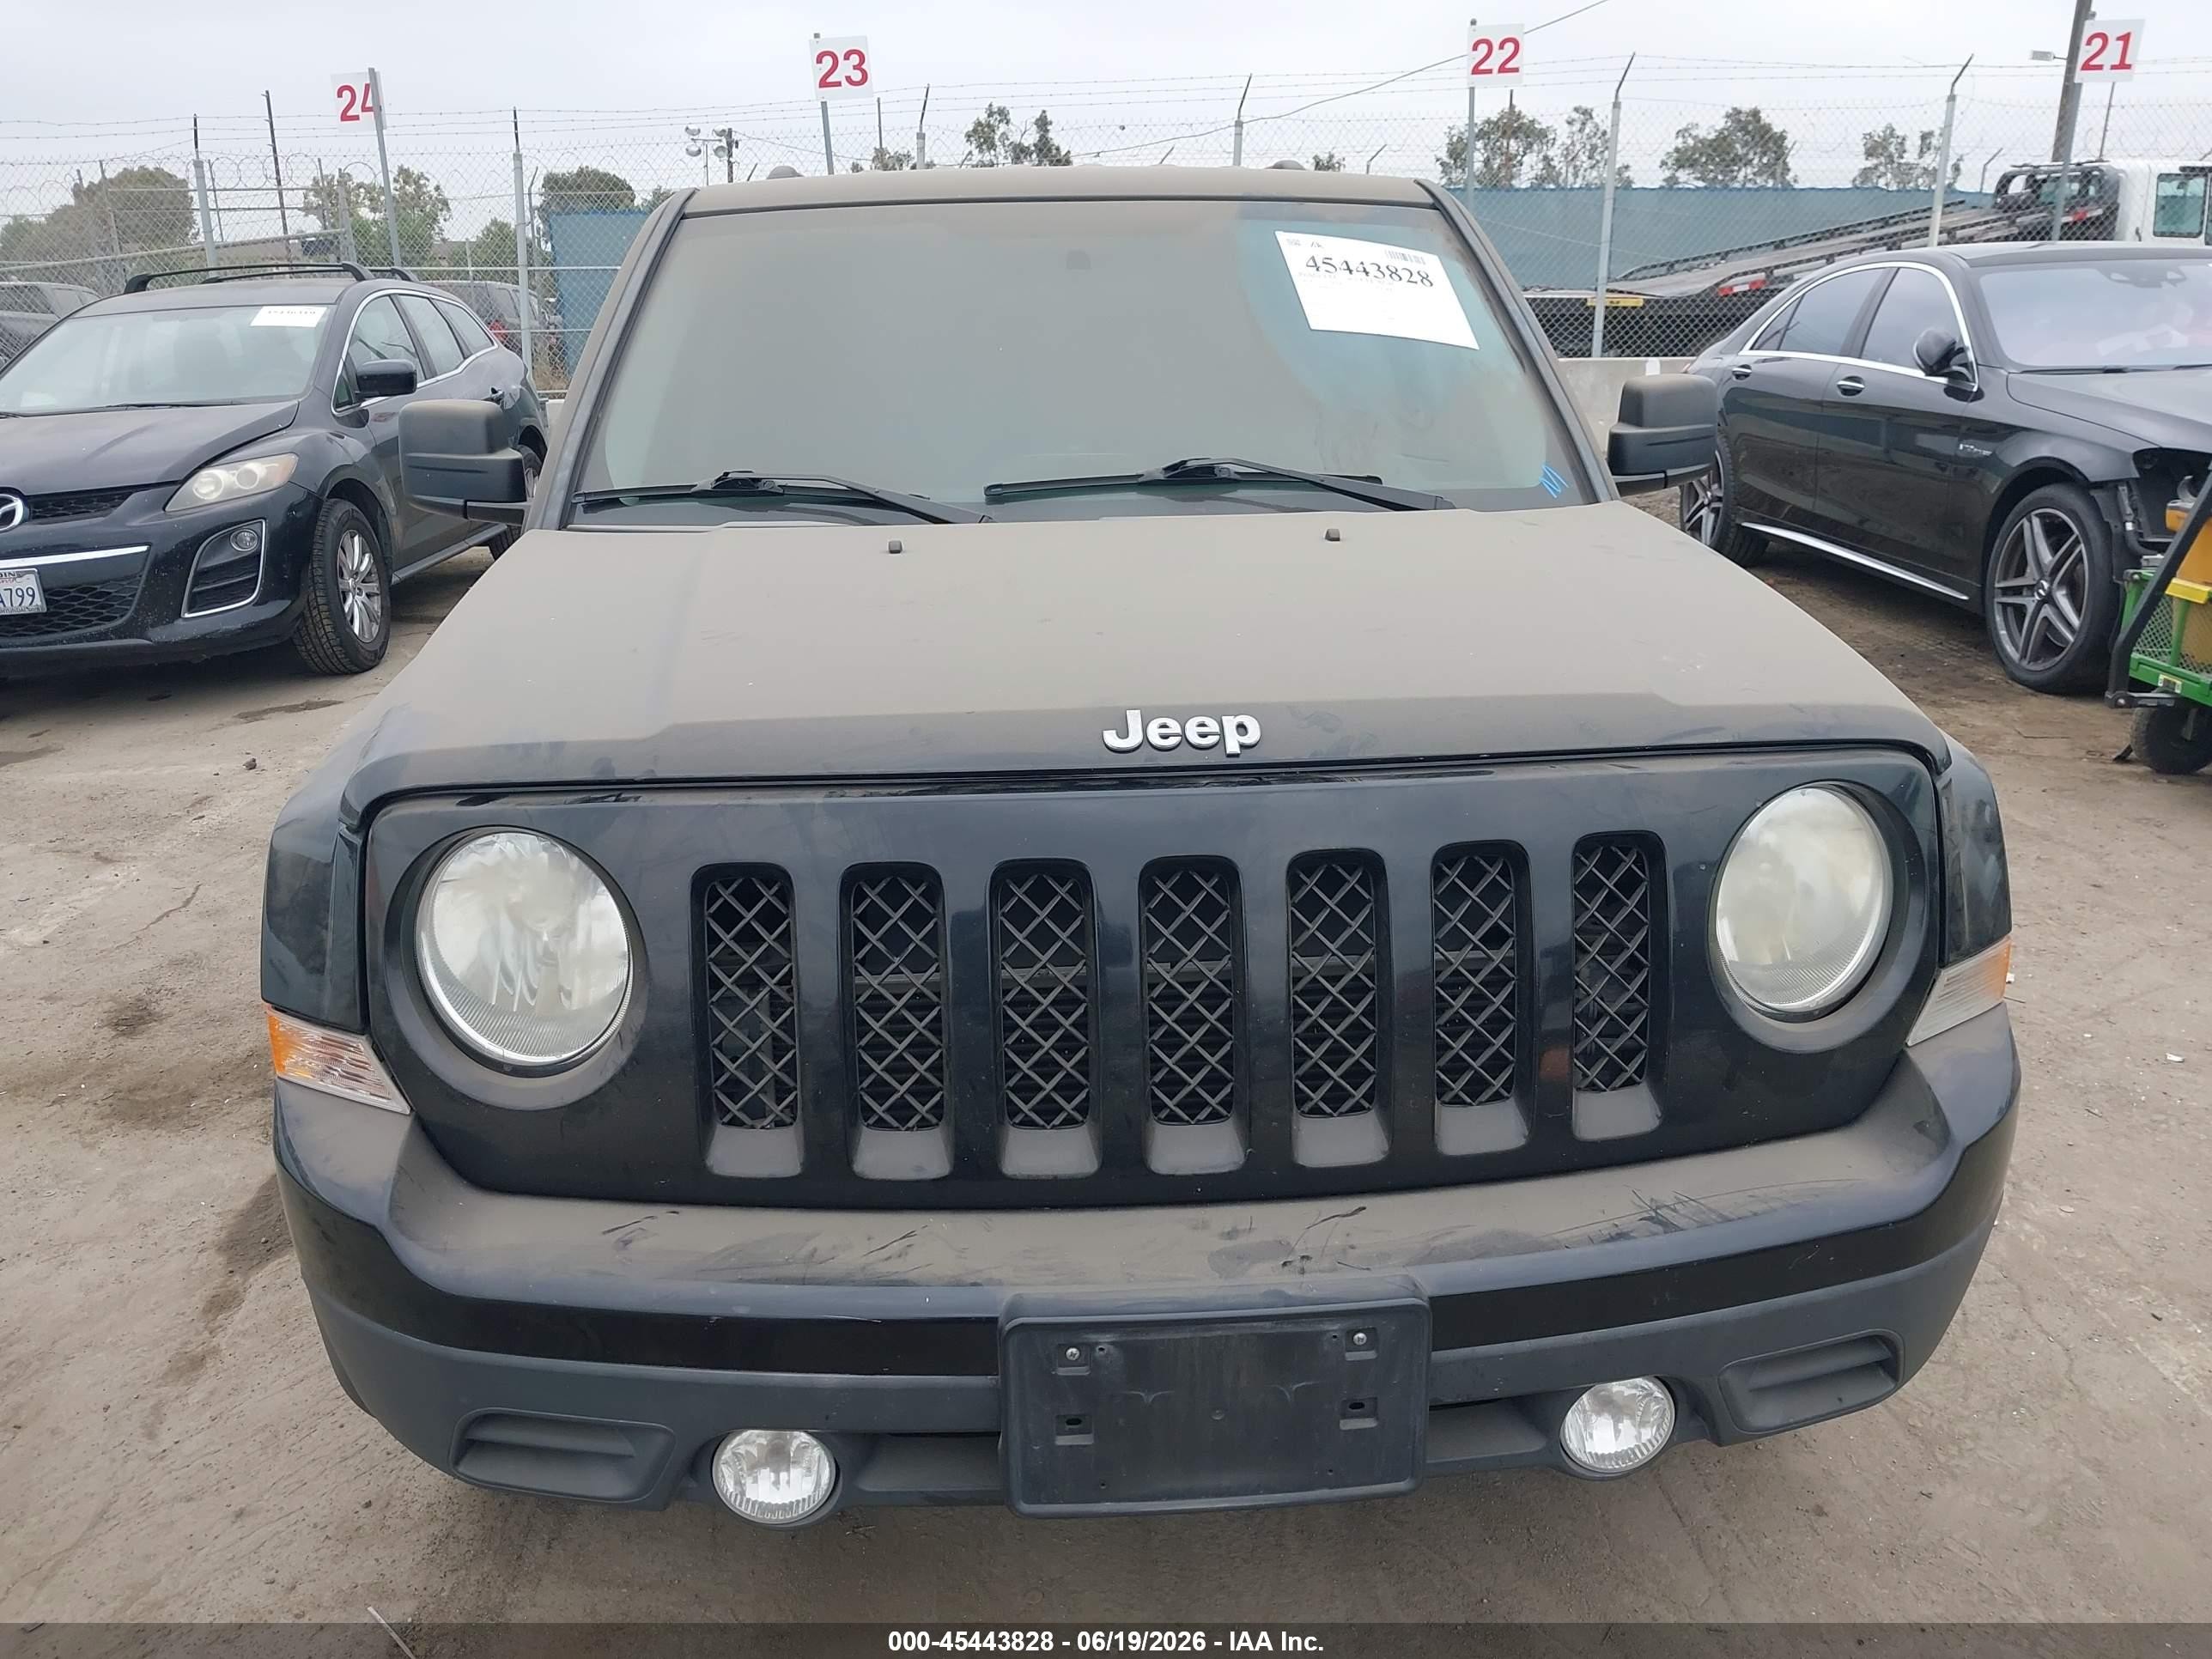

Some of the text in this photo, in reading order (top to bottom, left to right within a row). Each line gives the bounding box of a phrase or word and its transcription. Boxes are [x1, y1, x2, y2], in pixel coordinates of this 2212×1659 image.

[816, 49, 868, 88] 23
[1471, 37, 1520, 75] 22
[2081, 32, 2132, 70] 21
[1305, 255, 1434, 288] 45443828
[1103, 709, 1261, 757] Jeep
